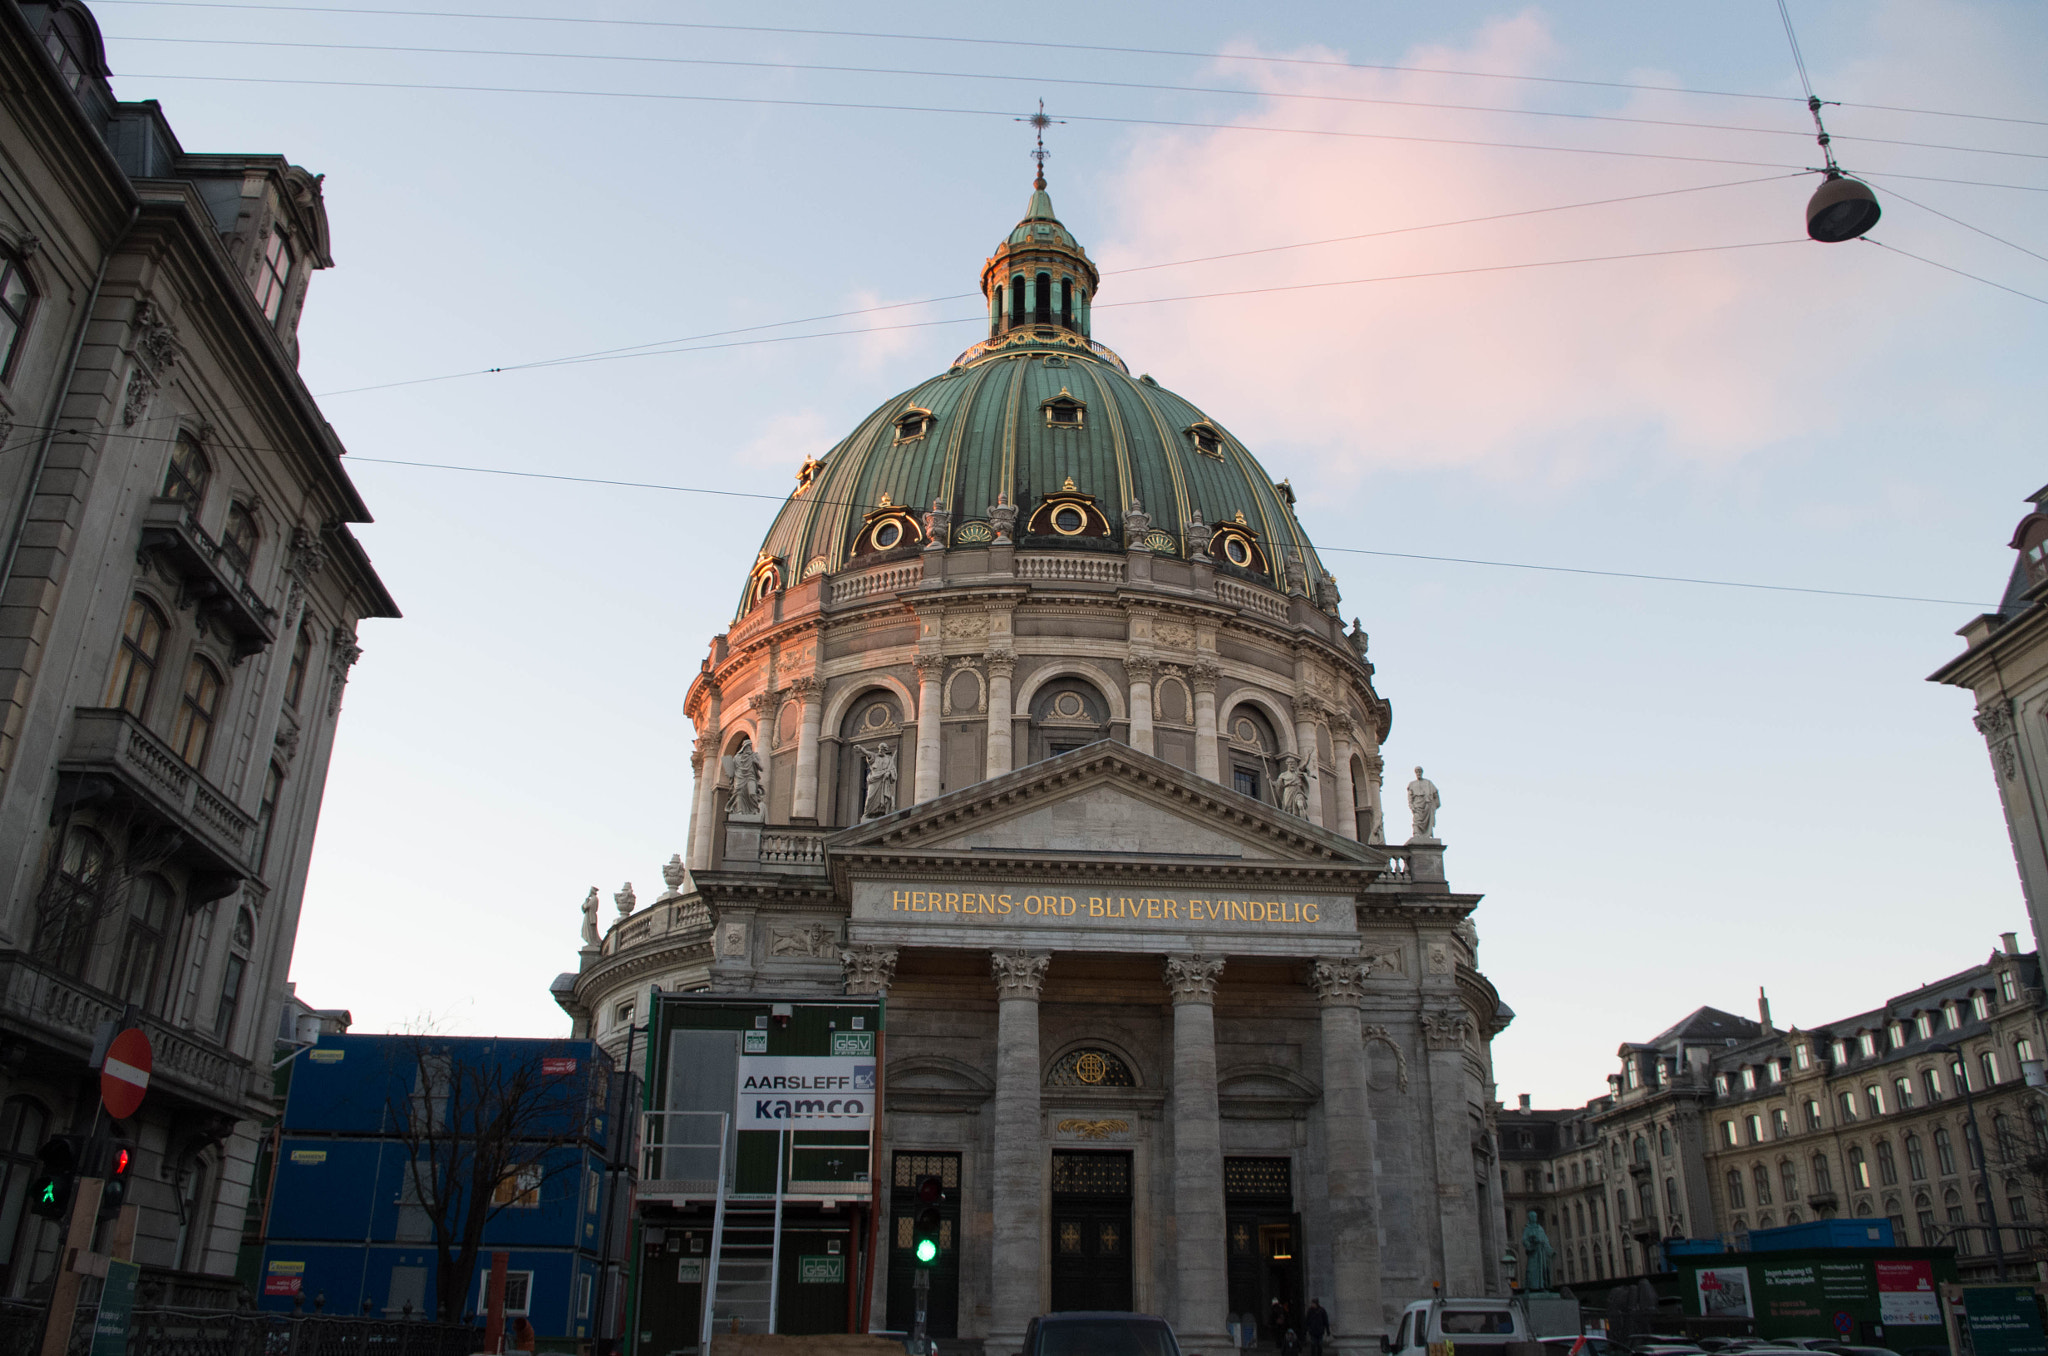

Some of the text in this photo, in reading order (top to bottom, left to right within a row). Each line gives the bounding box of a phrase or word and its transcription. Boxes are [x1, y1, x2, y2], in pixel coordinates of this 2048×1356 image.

[892, 890, 1321, 924] HERRENS ORD BLIVER EVINDELIG
[836, 1039, 869, 1049] GSV
[744, 1076, 850, 1089] AARSLEFF
[805, 1265, 838, 1275] GSV
